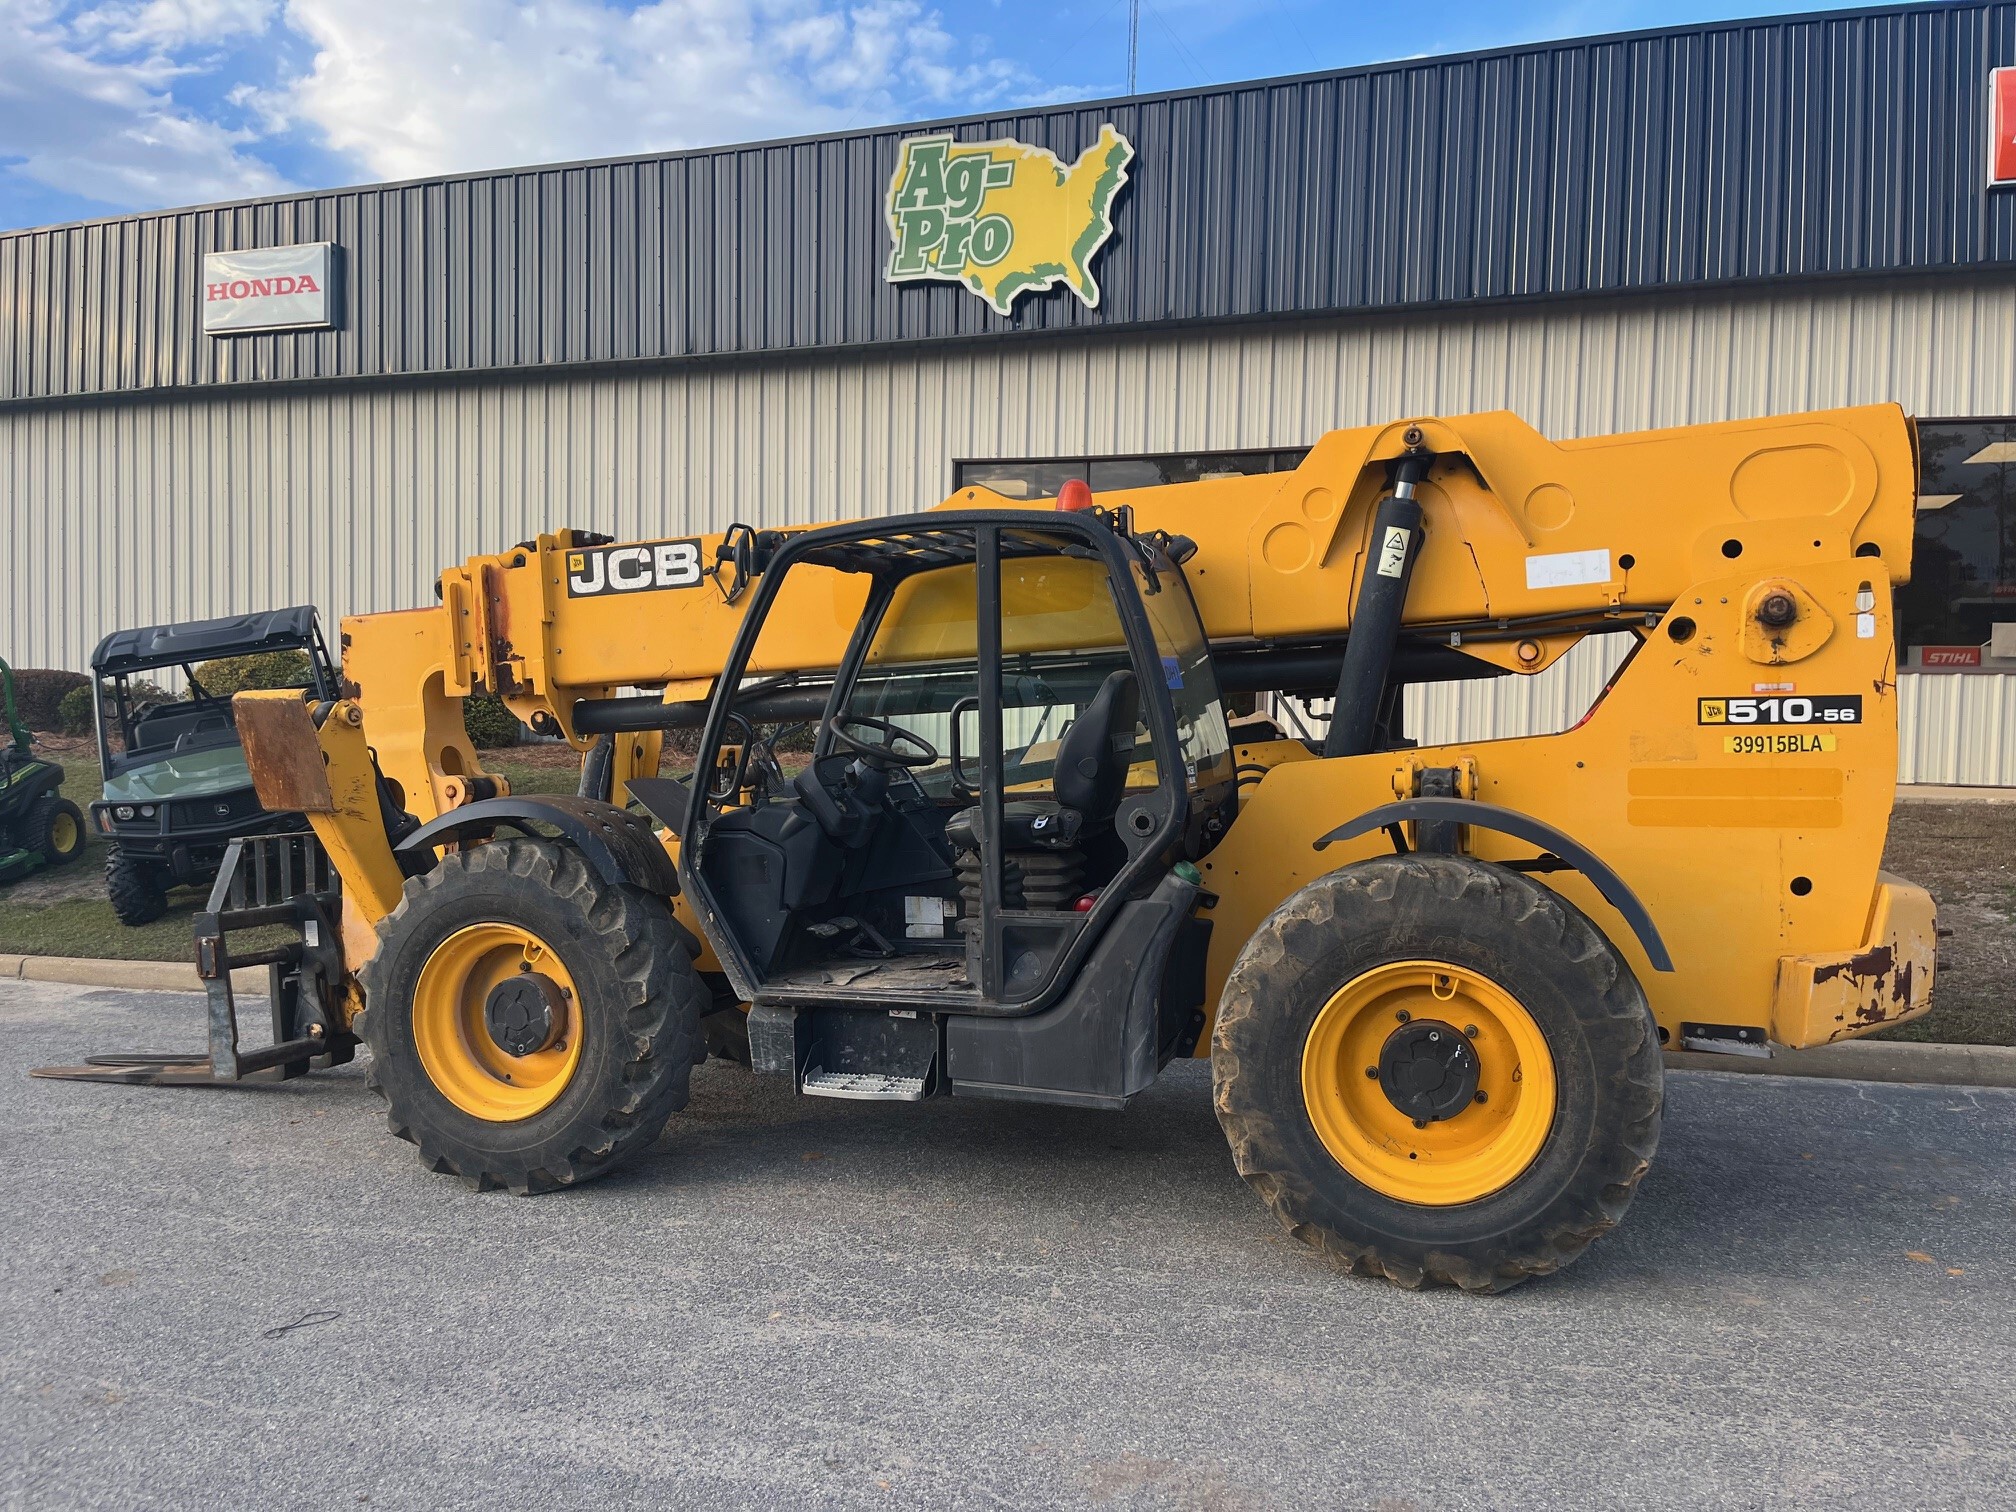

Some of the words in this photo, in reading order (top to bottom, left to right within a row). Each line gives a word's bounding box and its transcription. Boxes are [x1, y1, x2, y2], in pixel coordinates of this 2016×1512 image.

[896, 142, 1012, 219] Ag-
[895, 208, 1012, 270] Pro
[207, 275, 320, 301] HONDA
[571, 543, 700, 594] JCB
[1928, 652, 1975, 664] STIHL
[1733, 735, 1822, 753] 39915BLA
